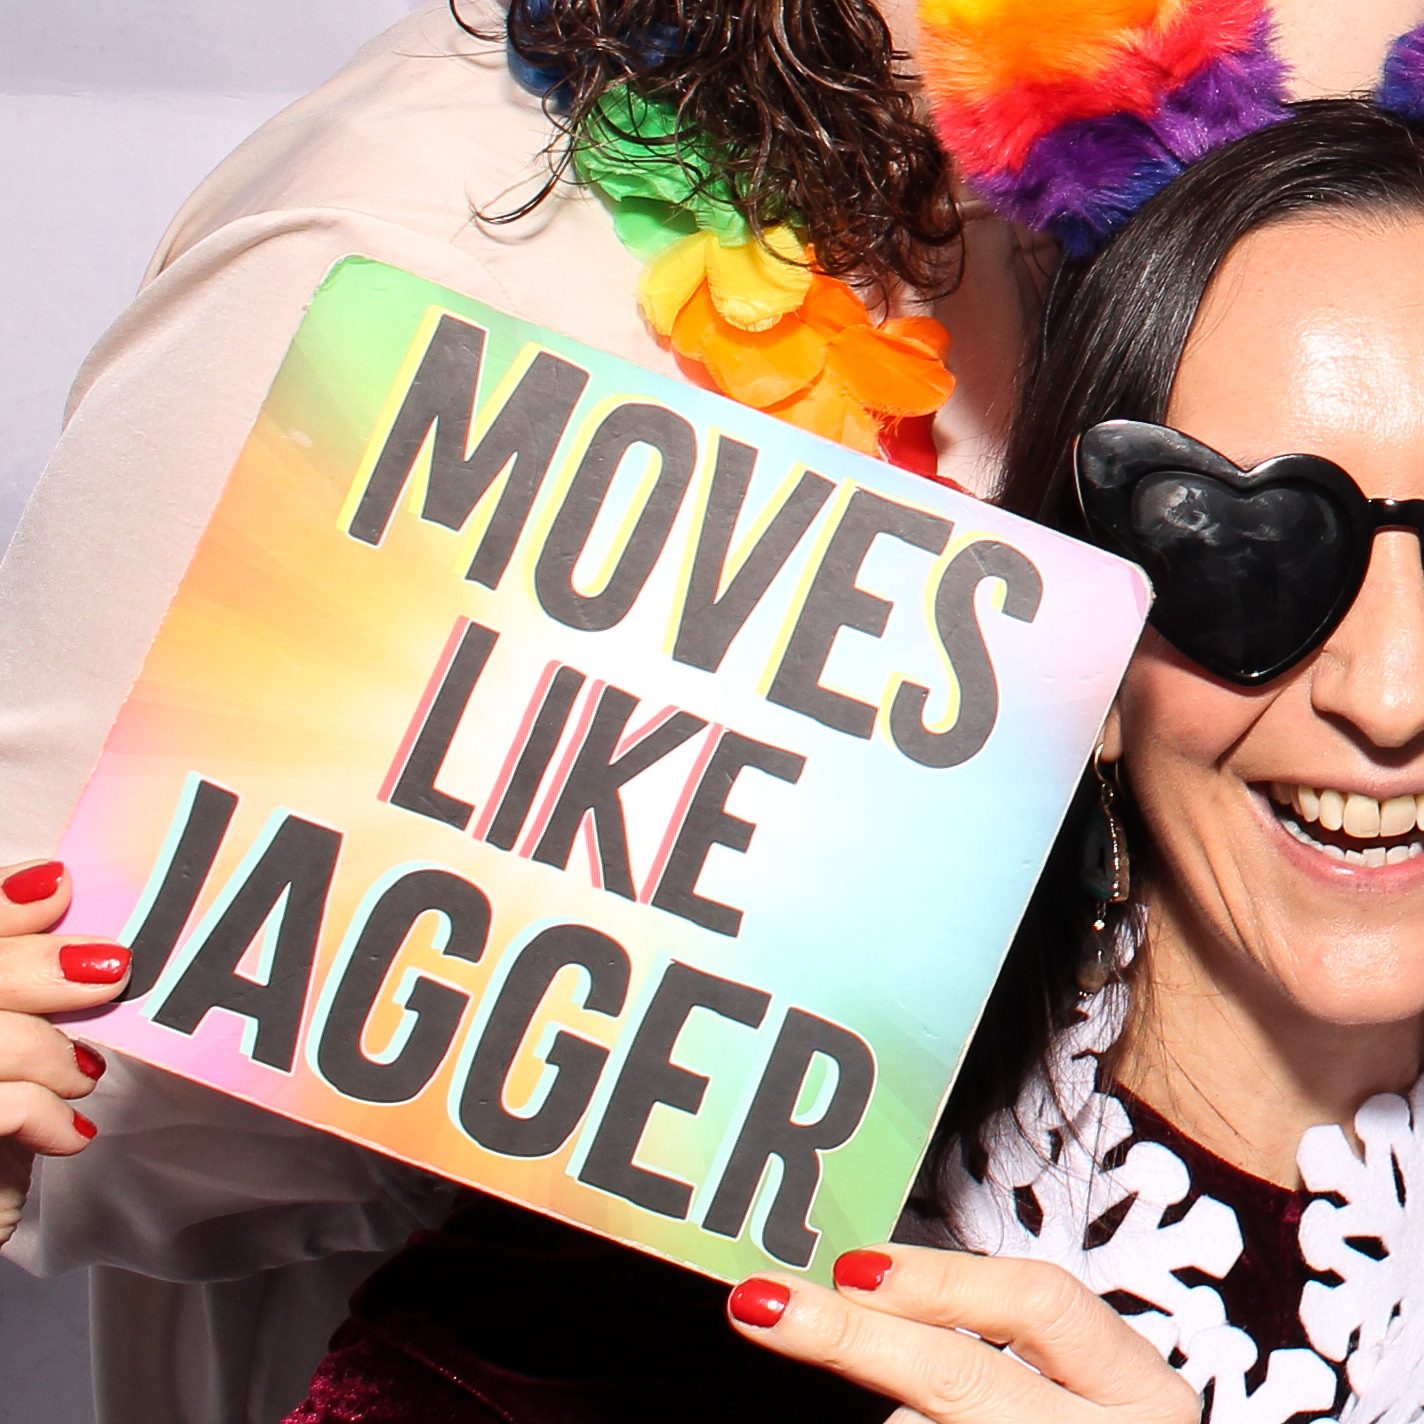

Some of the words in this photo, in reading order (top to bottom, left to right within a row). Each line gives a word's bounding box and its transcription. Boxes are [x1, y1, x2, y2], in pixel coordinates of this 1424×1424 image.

[340, 307, 1043, 768] MOVES
[380, 616, 806, 937] LIKE
[112, 772, 877, 1269] JAGGER
